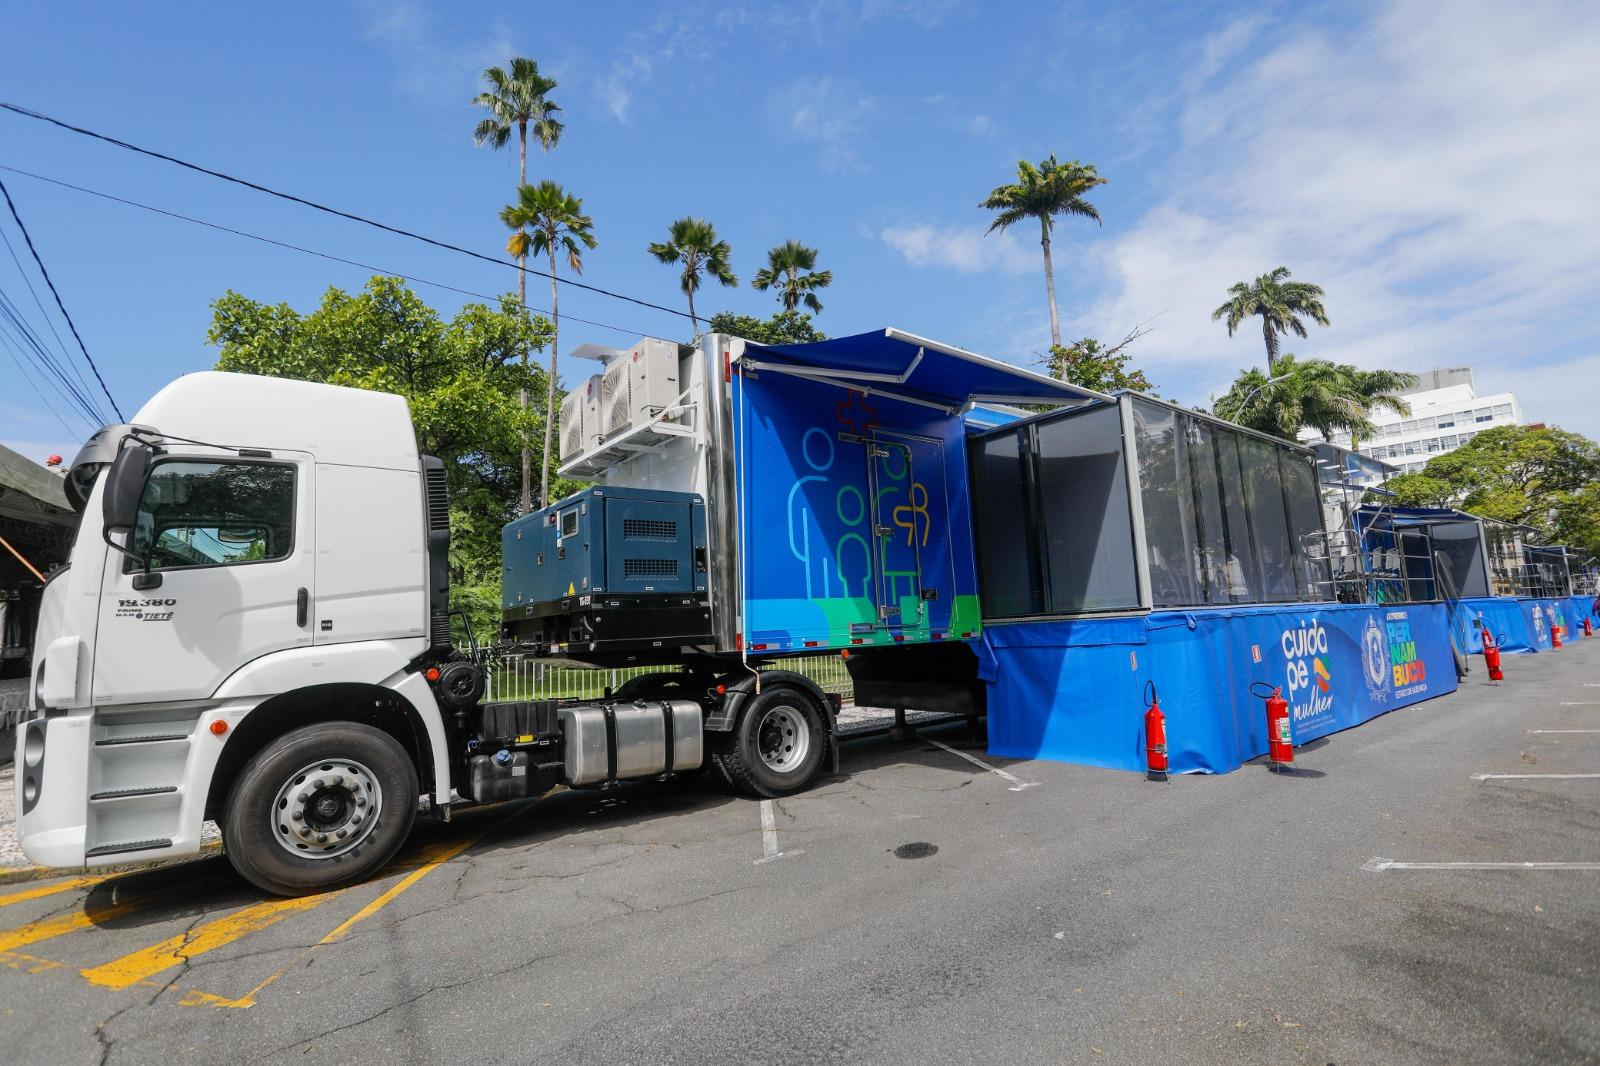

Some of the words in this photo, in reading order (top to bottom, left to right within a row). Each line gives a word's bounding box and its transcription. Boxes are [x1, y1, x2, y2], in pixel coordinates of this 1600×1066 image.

[1281, 618, 1328, 659] cuida
[1386, 621, 1411, 645] PER
[1390, 640, 1417, 665] NAM
[1287, 659, 1308, 702] pe
[1392, 658, 1425, 687] BUCO
[1293, 684, 1334, 723] mulher
